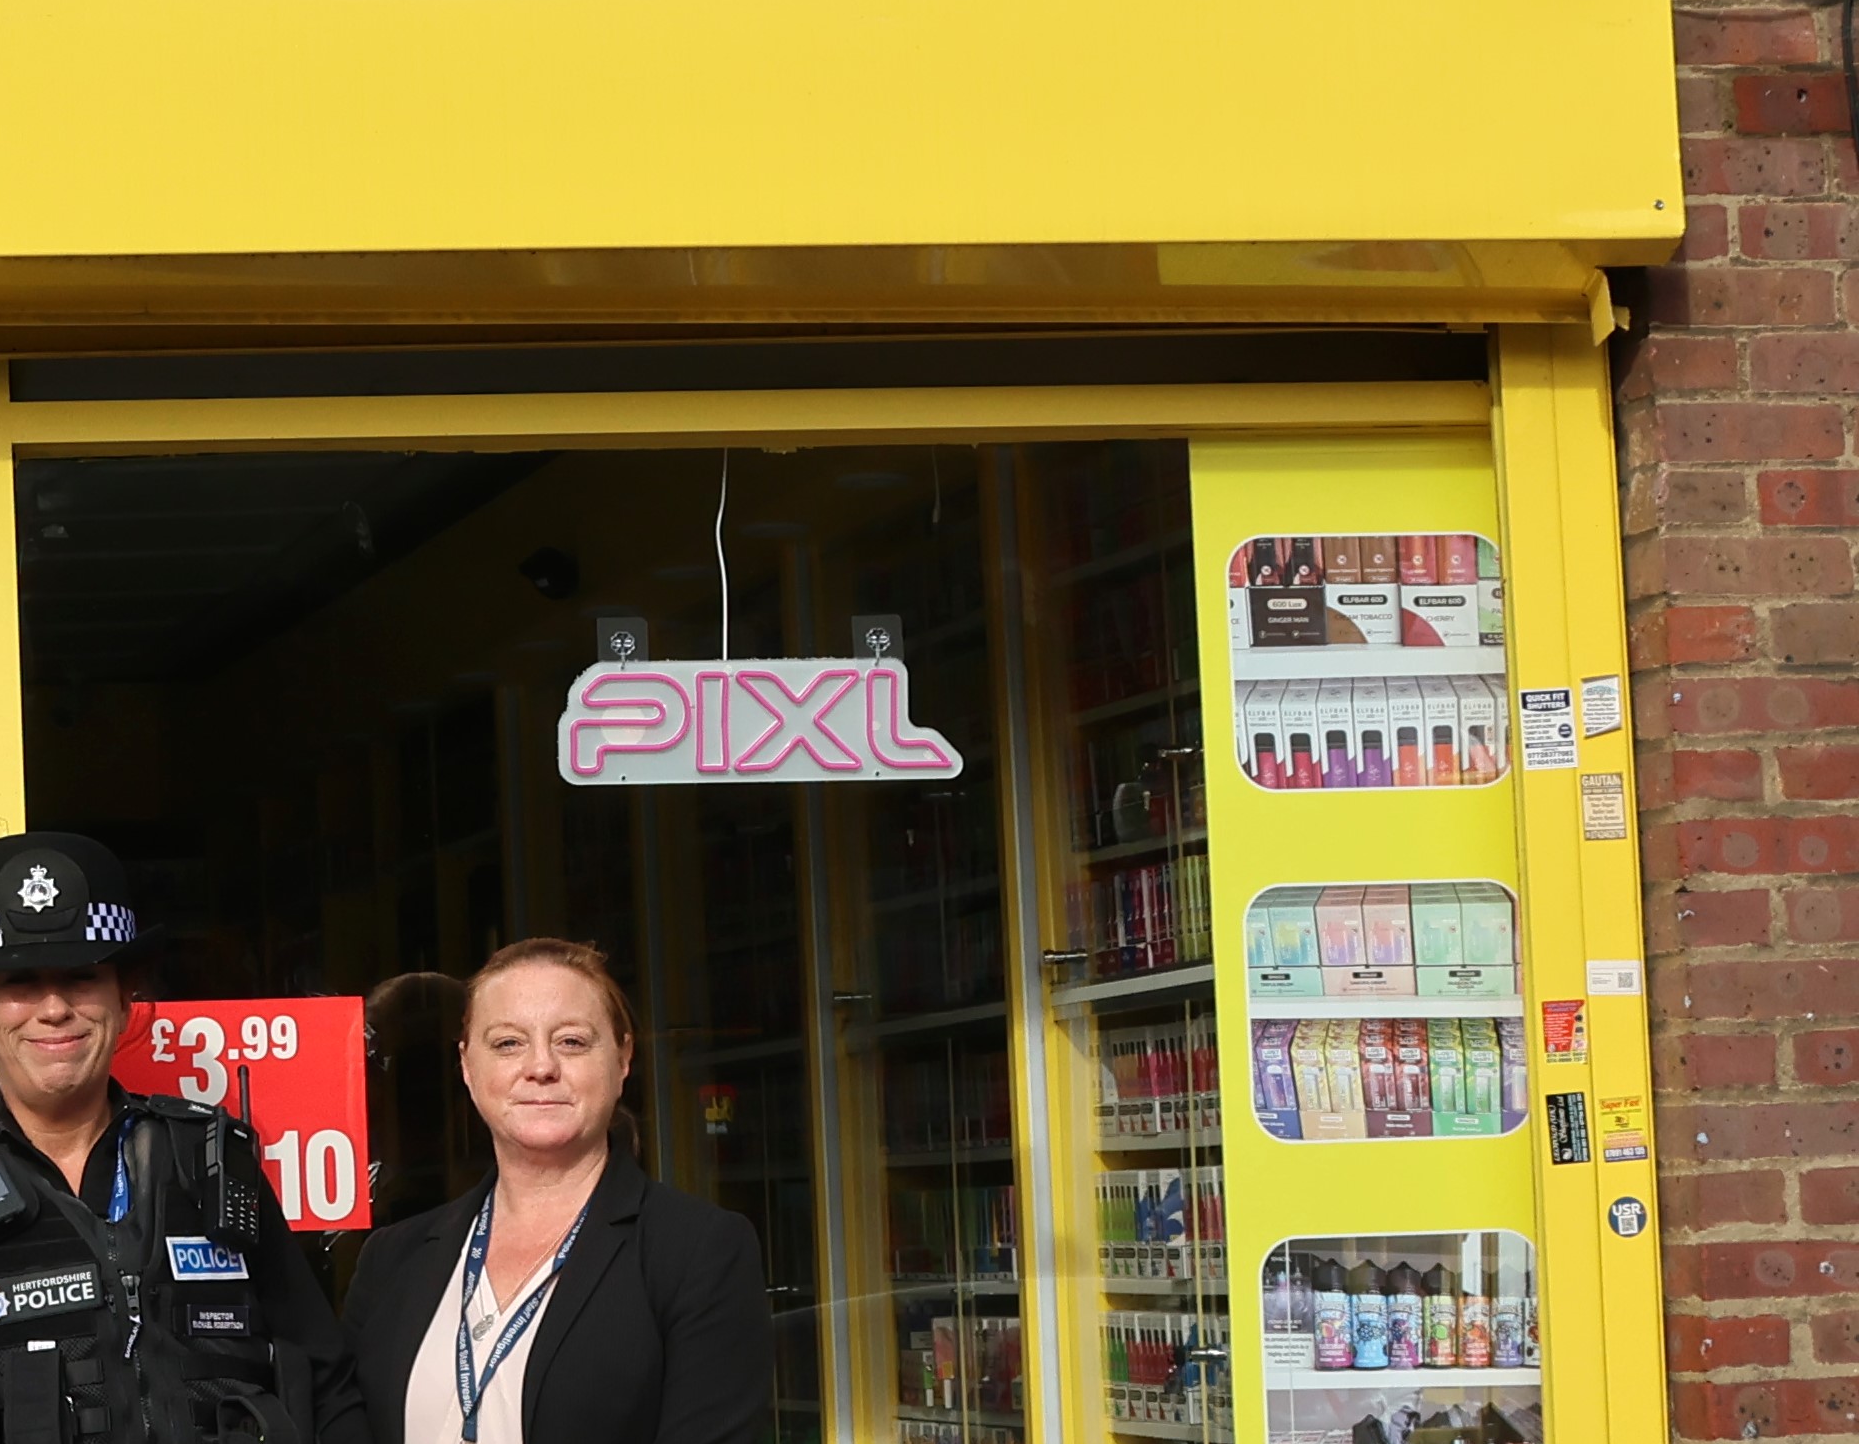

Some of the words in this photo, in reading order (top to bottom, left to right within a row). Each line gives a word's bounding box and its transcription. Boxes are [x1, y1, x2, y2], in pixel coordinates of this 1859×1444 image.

[1526, 693, 1551, 703] QUICK
[1553, 692, 1566, 701] FIT
[570, 669, 952, 774] PIXL
[151, 1015, 299, 1106] £3.99
[264, 1128, 357, 1222] 10
[1611, 1203, 1641, 1218] USR
[176, 1247, 241, 1270] POLICE
[12, 1271, 93, 1293] HERTFORDSHIRE
[14, 1283, 95, 1312] POLICE
